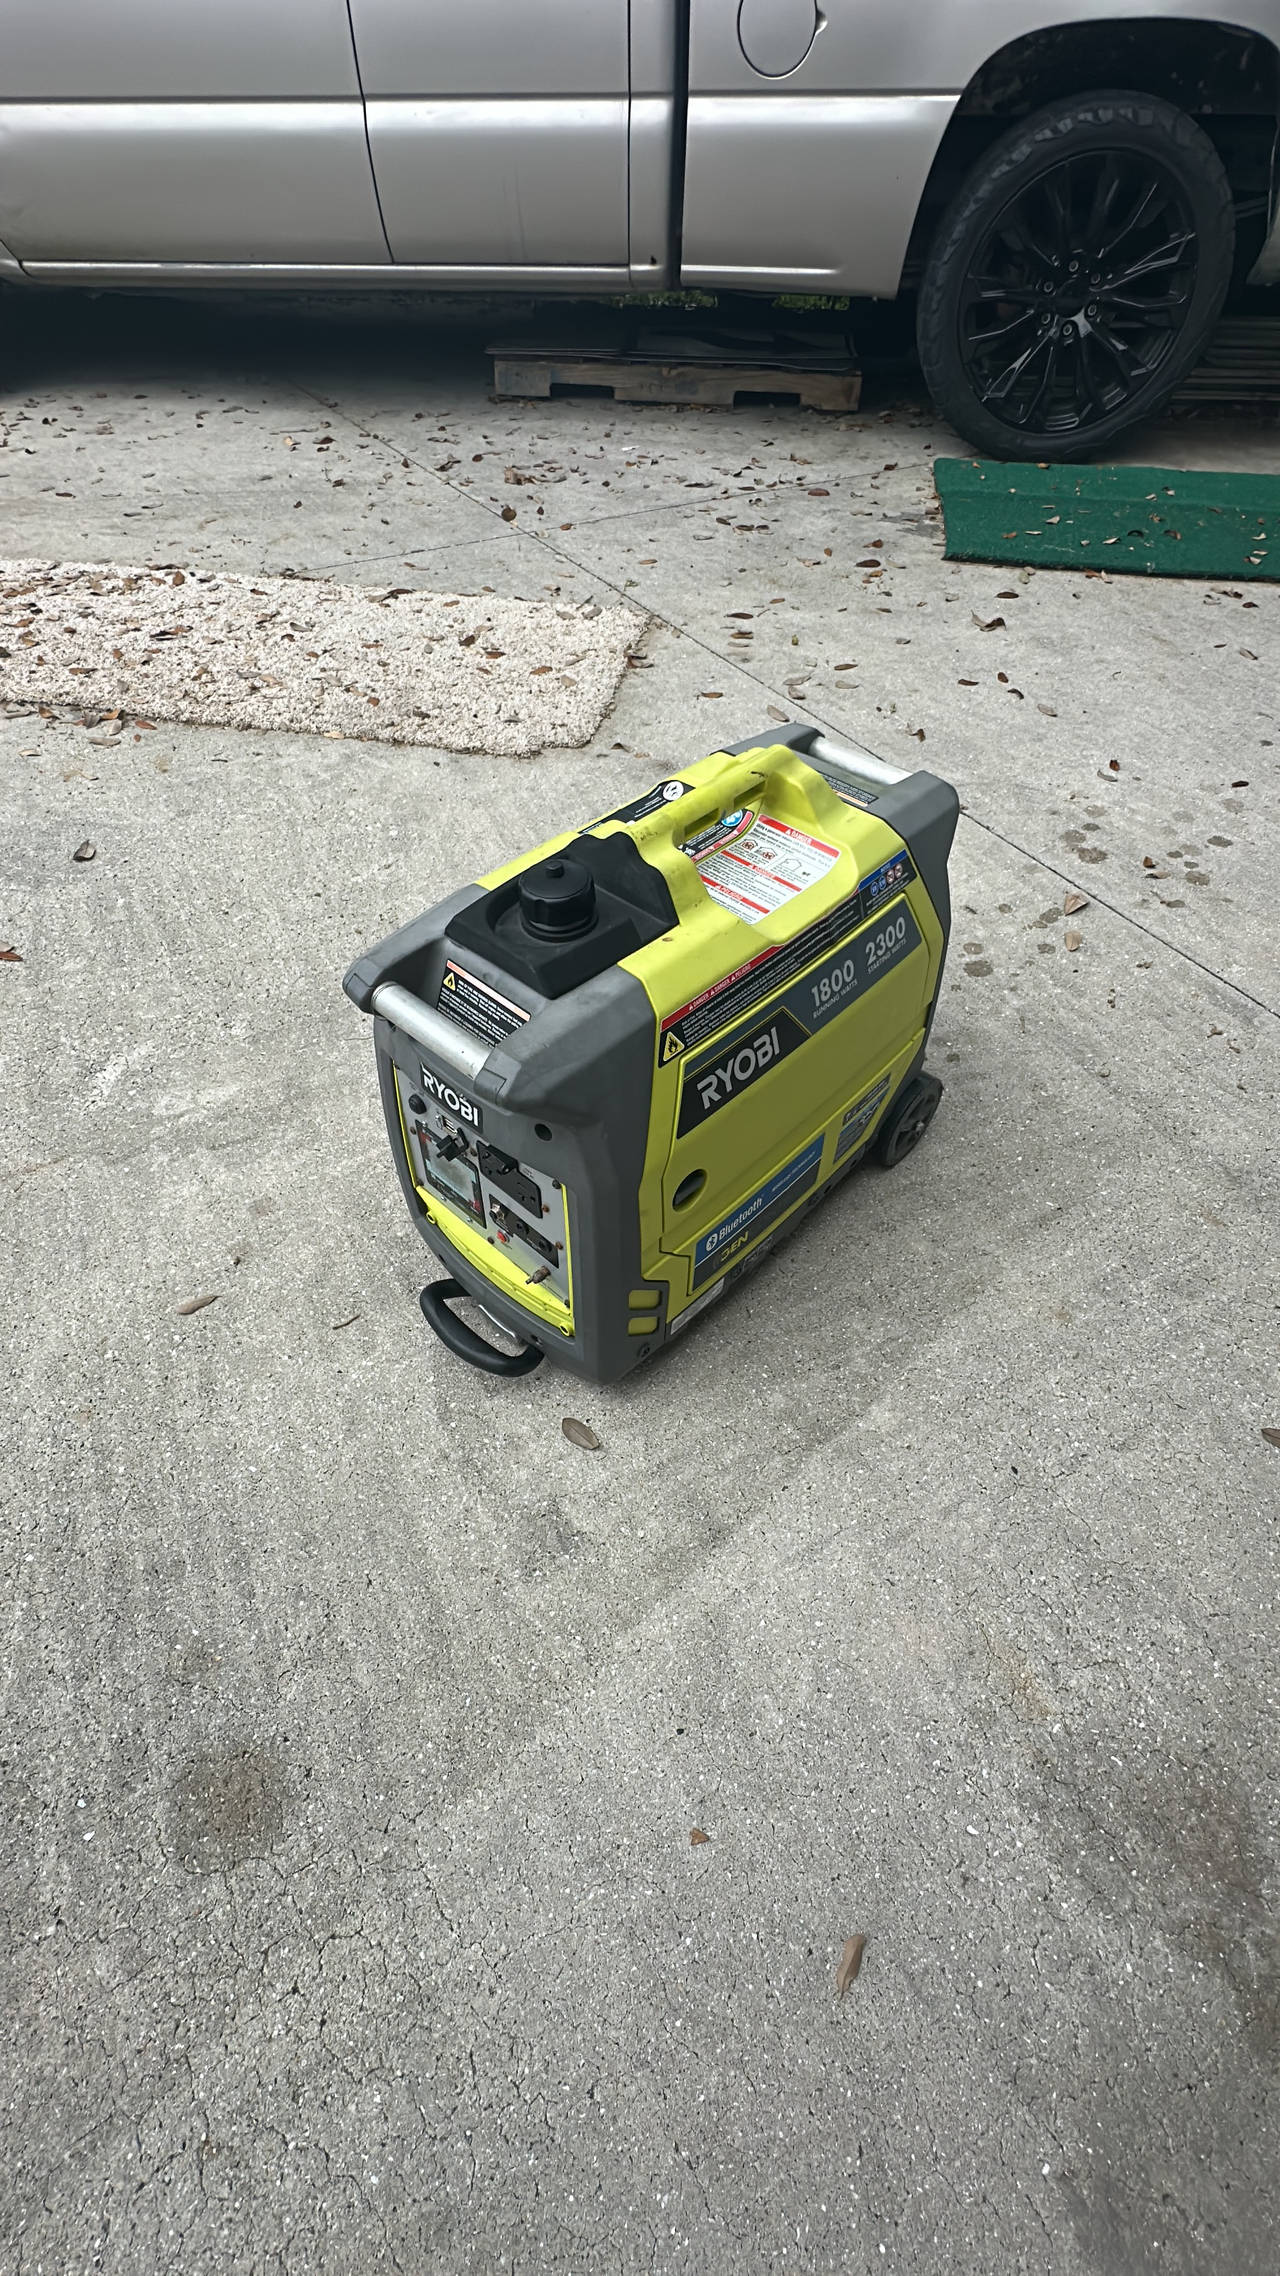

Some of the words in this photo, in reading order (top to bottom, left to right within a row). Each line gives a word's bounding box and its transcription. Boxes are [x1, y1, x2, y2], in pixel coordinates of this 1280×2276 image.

[865, 916, 906, 966] 2300
[867, 951, 892, 975] STARTING
[811, 959, 855, 1007] 1800
[813, 993, 840, 1019] RUNNING
[840, 978, 858, 997] WATTS
[697, 1026, 780, 1110] RYOBI
[421, 1062, 479, 1127] RYOBI
[719, 1197, 763, 1241] Bluetooth
